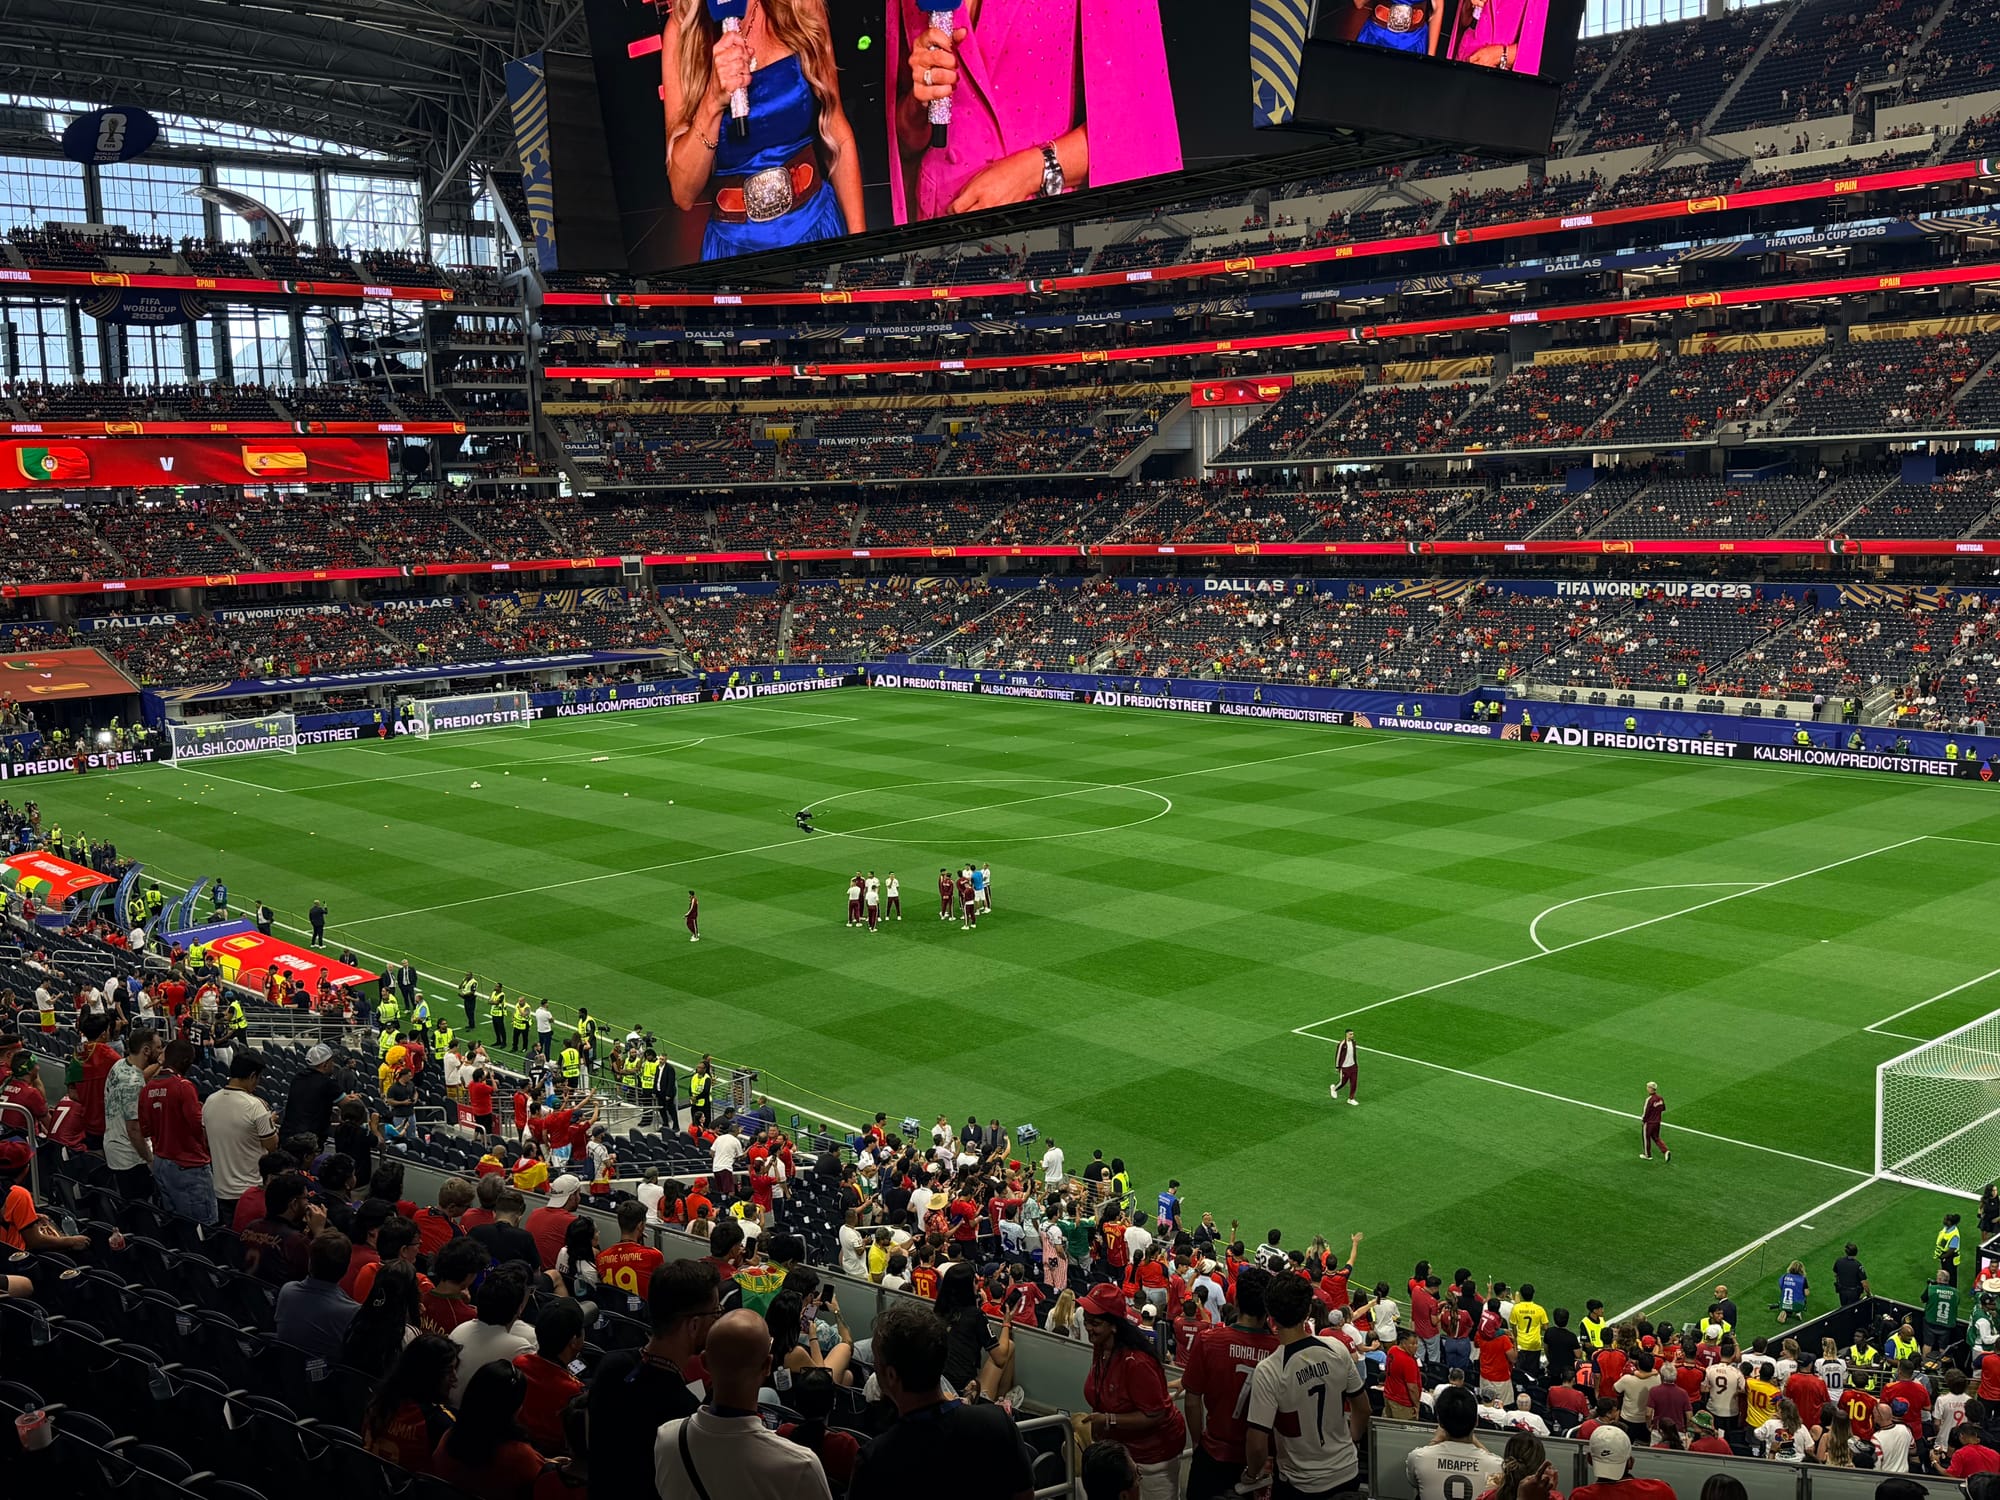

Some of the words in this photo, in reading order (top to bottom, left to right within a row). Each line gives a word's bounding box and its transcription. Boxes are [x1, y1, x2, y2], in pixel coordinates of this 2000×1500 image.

[1834, 180, 1857, 192] SPAIN
[1561, 216, 1593, 228] PORTUGAL
[1766, 238, 1787, 248] FIFA
[1788, 233, 1825, 246] WORLD
[1826, 230, 1847, 241] CUP
[1849, 226, 1886, 238] 2026
[1336, 247, 1352, 256] SPAIN
[1545, 259, 1602, 272] DALLAS
[0, 271, 31, 280] ORTUGAL
[196, 279, 216, 288] SPAIN
[1127, 271, 1153, 280] PORTUGAL
[1880, 277, 1901, 287] SPAIN
[363, 287, 393, 296] PORTUGAL
[932, 289, 948, 297] SPAIN
[1302, 290, 1340, 301] #FIFAWorldCup
[140, 297, 160, 306] FIFA
[714, 296, 742, 304] PORTUGAL
[122, 304, 156, 314] WORLD
[1077, 312, 1121, 321] DALLAS
[1510, 312, 1538, 323] PORTUGAL
[685, 330, 734, 339] DALLAS
[882, 326, 909, 334] WORLD
[926, 323, 952, 331] 2026
[11, 424, 42, 434] PORTUGAL
[1956, 544, 1984, 552] PORTUGAL
[1204, 579, 1285, 592] DALLAS
[1557, 582, 1590, 596] FIFA
[1593, 583, 1651, 597] WORLD
[1658, 584, 1688, 597] CUP
[1690, 583, 1752, 598] 2026
[384, 598, 453, 610] DALLAS
[246, 608, 284, 619] WORLD
[93, 615, 177, 630] DALLAS
[331, 666, 439, 680] WORLD
[441, 662, 497, 670] CUP
[500, 654, 594, 666] 2026
[638, 684, 656, 693] FIFA
[722, 685, 753, 701] ADI
[756, 676, 844, 697] PREDICTSTREET
[875, 675, 900, 688] ADI
[903, 677, 974, 693] PREDICTSTREET
[1012, 677, 1028, 685] FIFA
[980, 684, 1075, 702] KALSHI.COM/PREDICTSTREET
[556, 691, 701, 717] KALSHI.COM/PREDICTSTREET
[1093, 690, 1121, 706] ADI
[1123, 693, 1213, 713] PREDICTSTREET
[1219, 702, 1344, 724] KALSHI.COM/PREDICTSTREET
[394, 719, 429, 735] AD
[434, 708, 543, 730] PREDICTSTREET
[1379, 716, 1399, 728] FIFA
[1399, 718, 1433, 731] WORLD
[1434, 721, 1453, 732] CUP
[1454, 722, 1487, 735] 2026
[176, 726, 360, 759] KALSHI.COM/PREDICTSTREET
[1544, 726, 1588, 747] ADI
[1593, 732, 1737, 758] PREDICTSTREET
[13, 748, 154, 777] PREDICSTRET
[1753, 745, 1958, 776] KALSHI.COM/PREDICTSTREET
[273, 954, 317, 971] SPAIN
[190, 1030, 201, 1045] 23
[51, 1106, 70, 1133] 7
[599, 1254, 618, 1264] AMINE
[619, 1252, 643, 1262] YAMAL
[601, 1266, 639, 1296] 19
[916, 1278, 930, 1298] 19
[420, 1317, 448, 1337] NALD
[1481, 1317, 1488, 1331] 7
[1524, 1316, 1532, 1333] 7
[1185, 1334, 1194, 1350] 7
[1229, 1344, 1269, 1361] RONALDO
[1296, 1361, 1329, 1385] RONALDO
[1825, 1372, 1841, 1389] 10
[1232, 1364, 1256, 1420] 7
[1715, 1376, 1727, 1394] 9
[1750, 1389, 1768, 1410] 10
[1308, 1384, 1326, 1447] 7
[1847, 1398, 1867, 1422] 10
[1953, 1410, 1964, 1426] 9
[1437, 1458, 1480, 1472] MBAPPÉ
